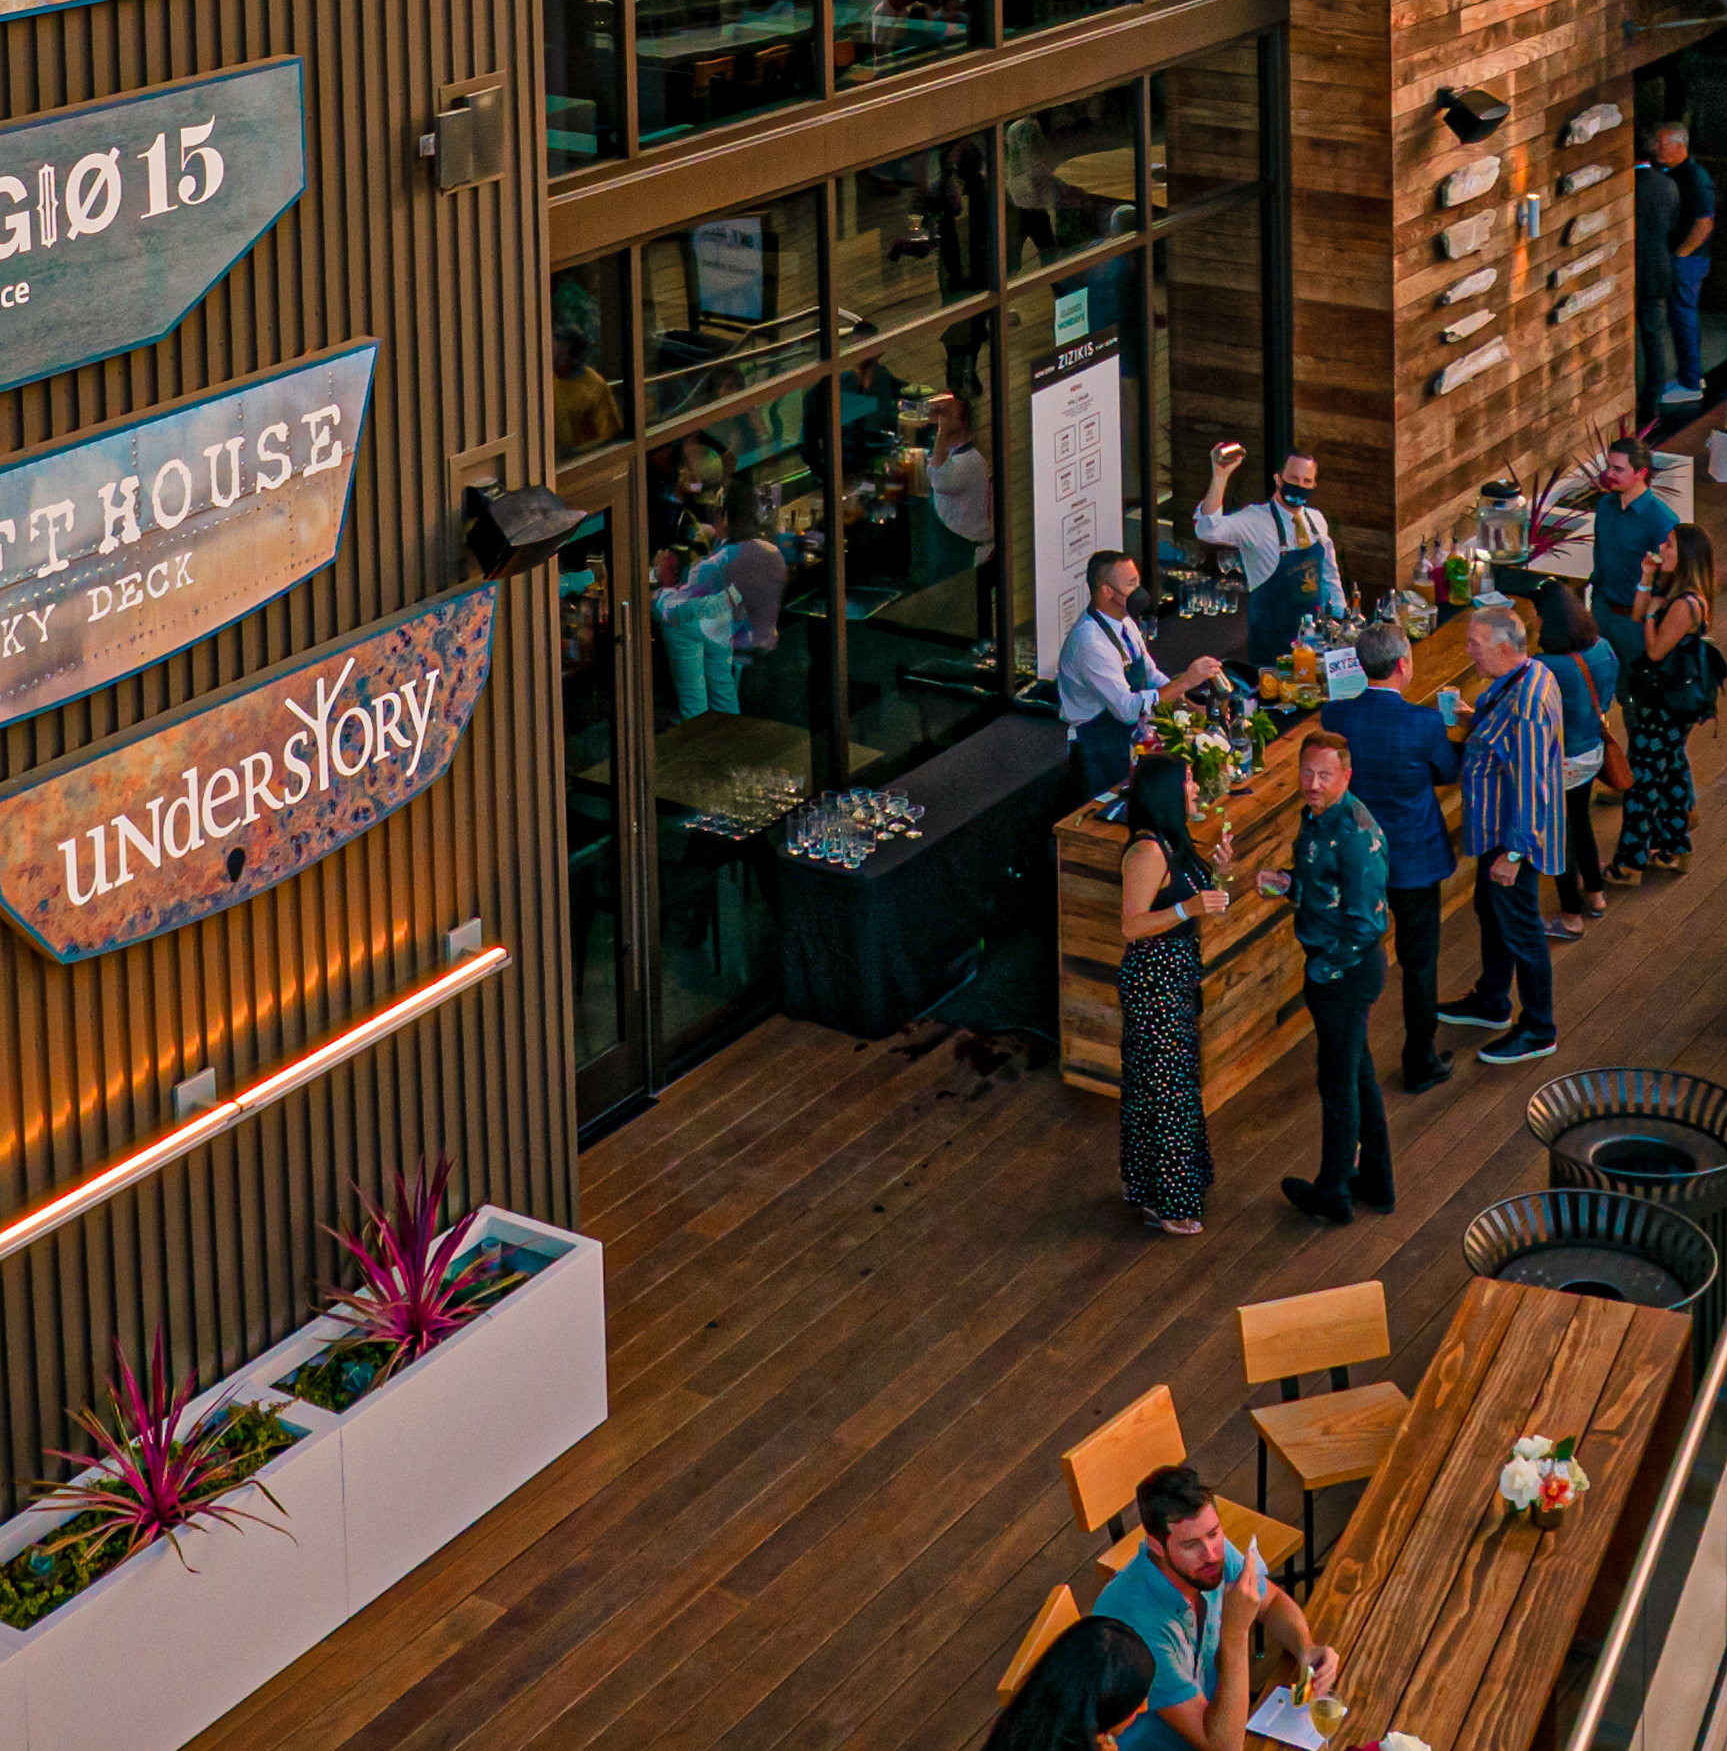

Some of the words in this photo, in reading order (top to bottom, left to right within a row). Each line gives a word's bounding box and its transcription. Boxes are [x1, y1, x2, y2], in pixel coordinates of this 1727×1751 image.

[137, 114, 225, 220] 15
[1057, 341, 1095, 370] ZIZIKIS
[86, 551, 196, 623] DECK
